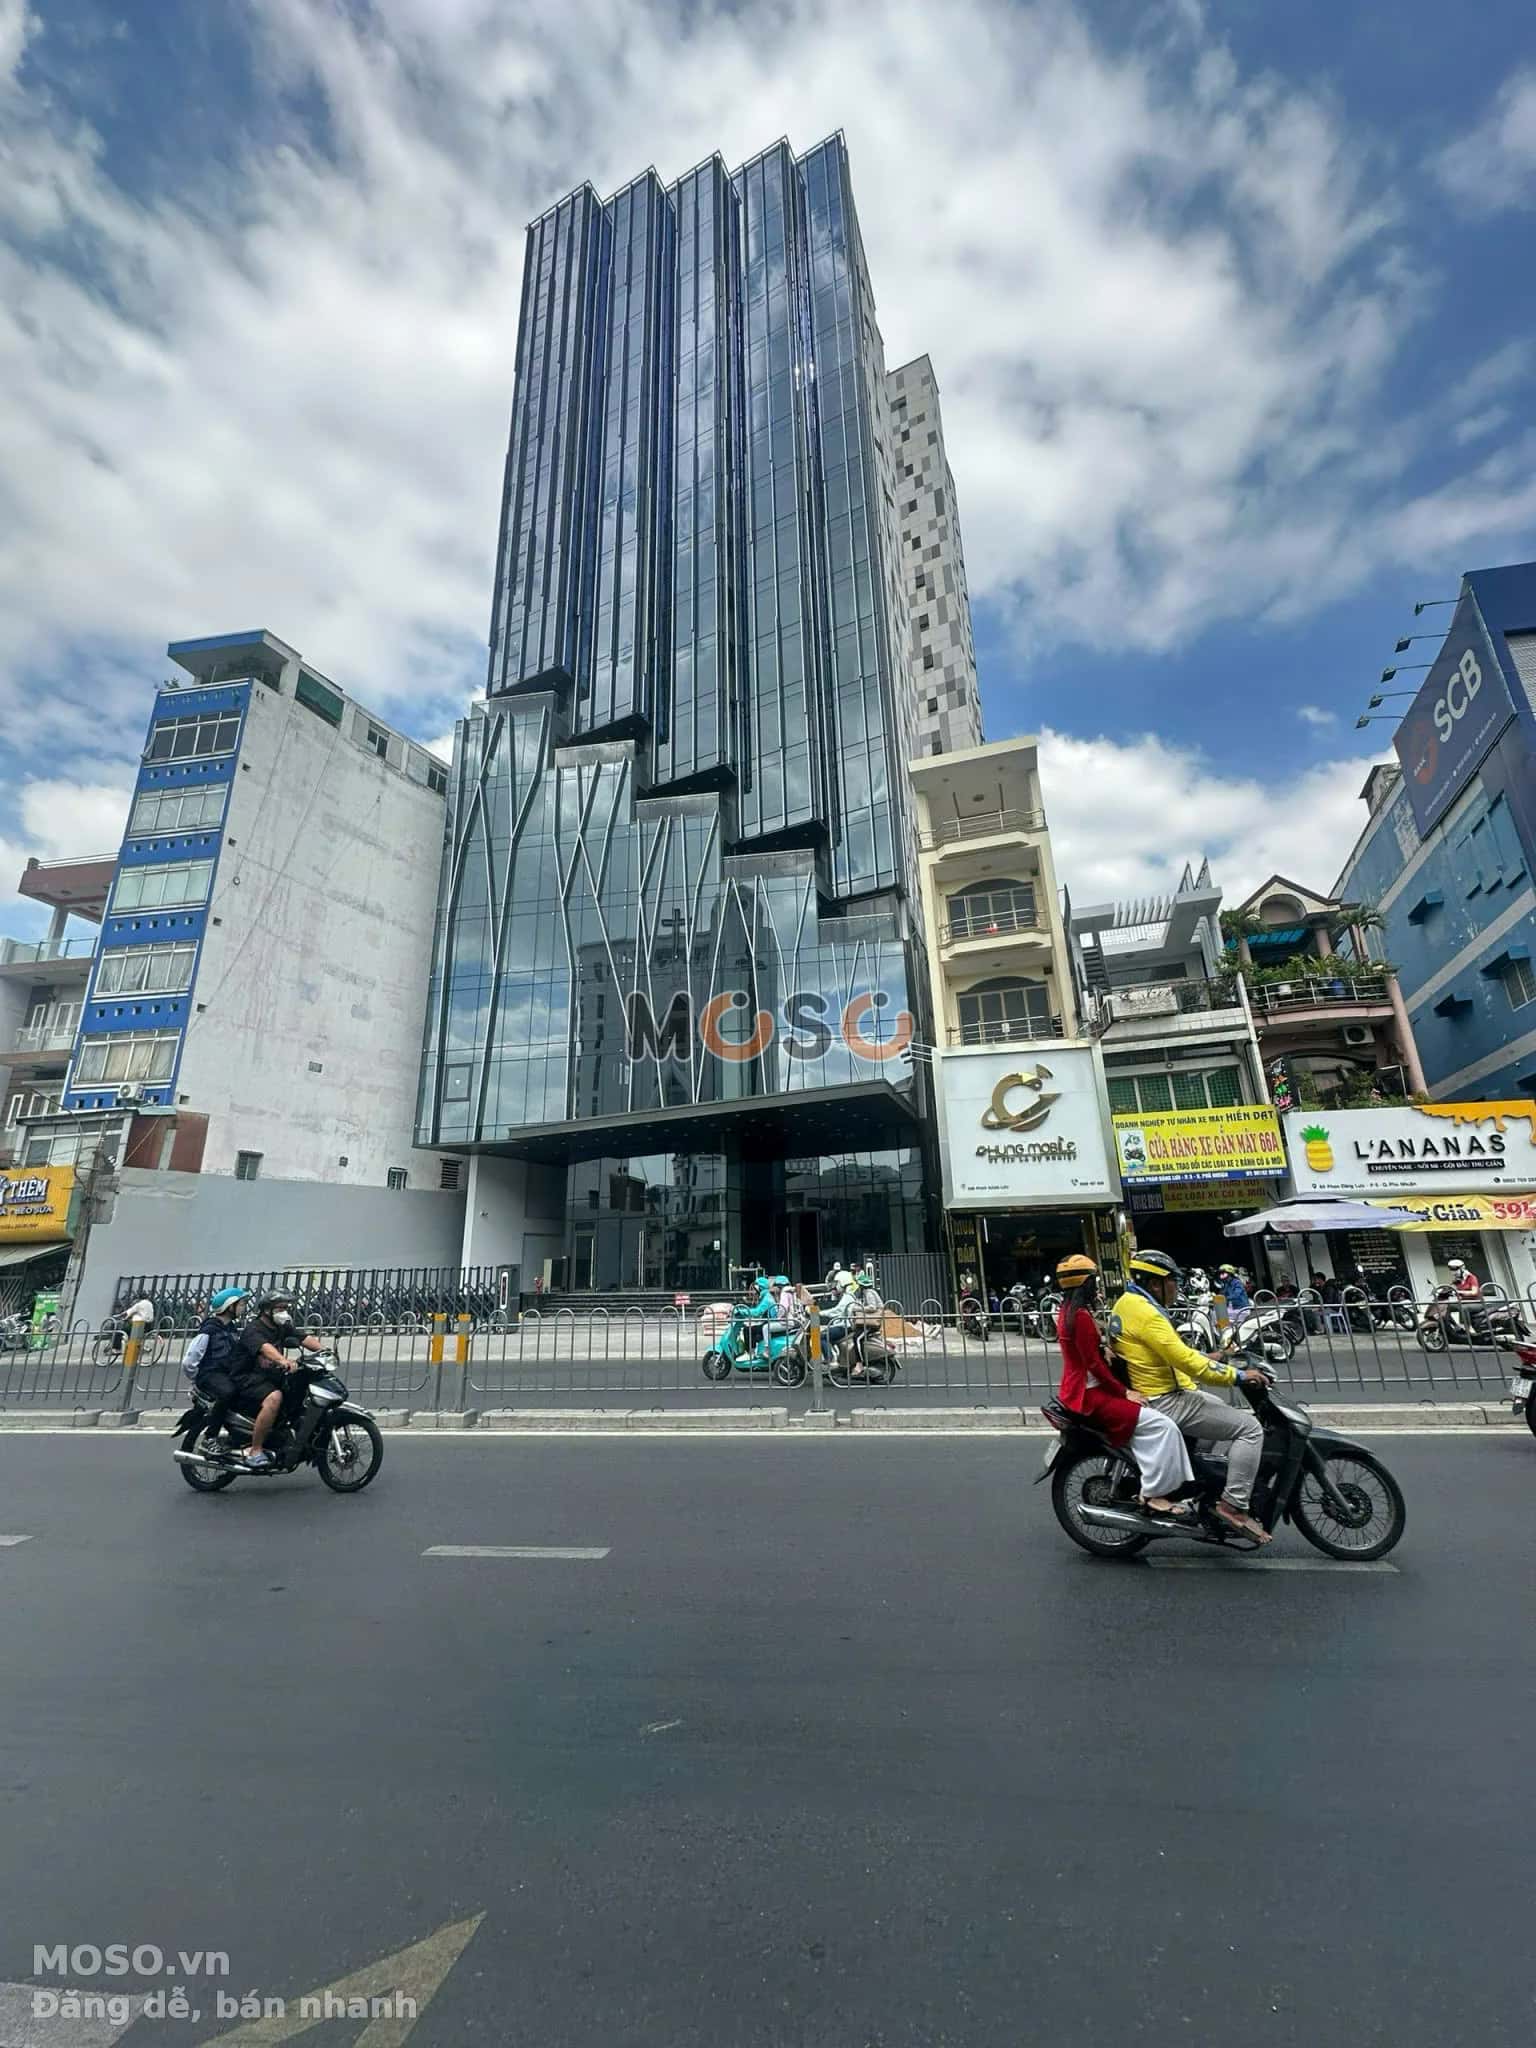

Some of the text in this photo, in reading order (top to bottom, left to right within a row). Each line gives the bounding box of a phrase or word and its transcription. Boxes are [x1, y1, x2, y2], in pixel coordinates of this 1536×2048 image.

[1433, 648, 1482, 743] SCB
[1198, 1116, 1208, 1124] XE
[1149, 1132, 1169, 1160] CỬA
[1170, 1132, 1198, 1158] HÀNG
[1200, 1136, 1213, 1156] XE
[1238, 1128, 1257, 1154] MÁY
[1258, 1132, 1280, 1152] 66A
[1432, 1204, 1482, 1222] Giãn
